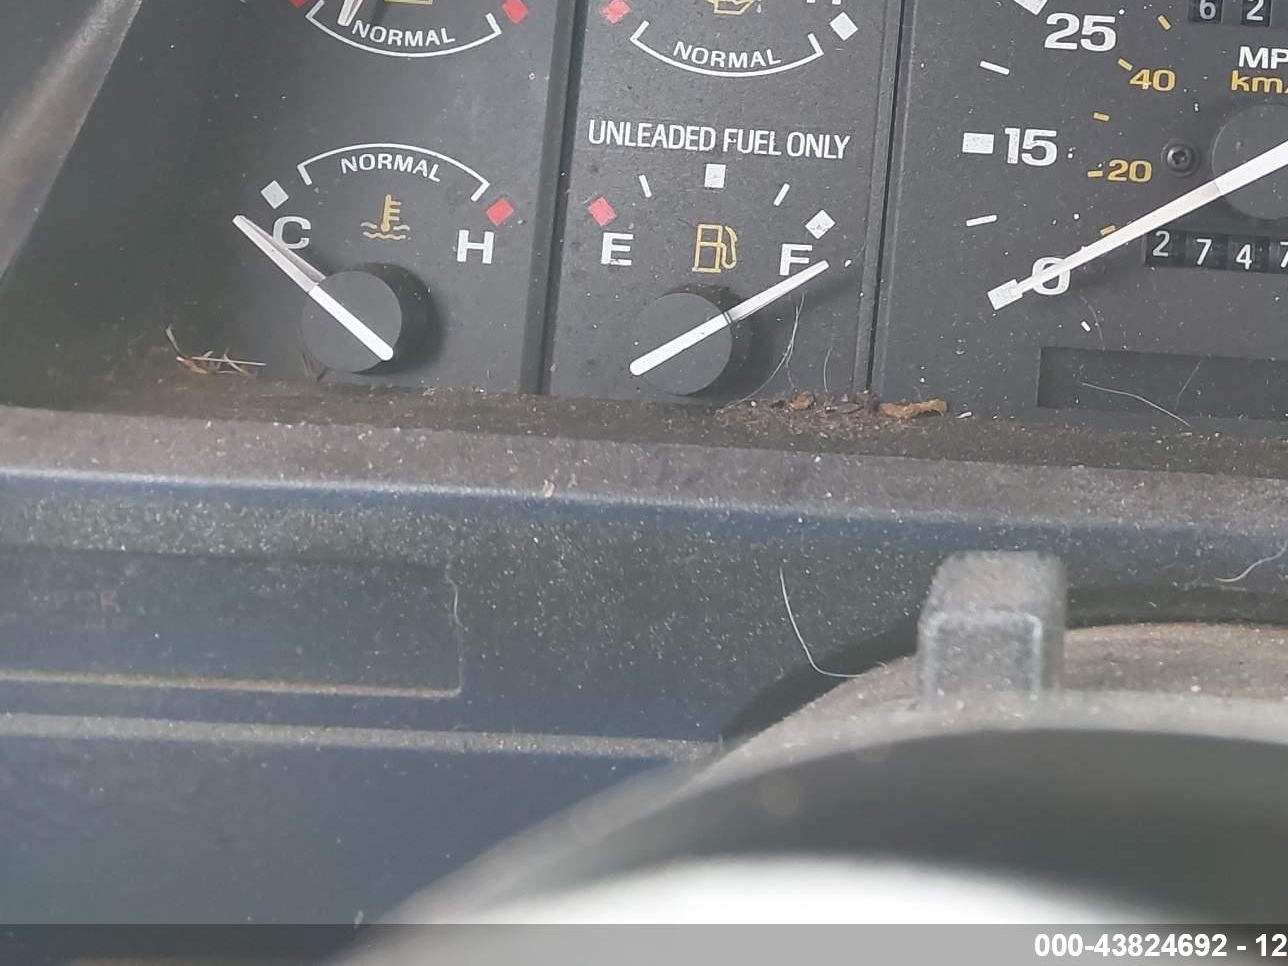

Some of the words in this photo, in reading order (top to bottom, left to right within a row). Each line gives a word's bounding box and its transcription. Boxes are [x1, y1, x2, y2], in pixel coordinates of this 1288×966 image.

[352, 19, 455, 48] NORMAL
[1045, 13, 1116, 51] 25
[673, 40, 782, 69] NORMAL
[1130, 70, 1175, 90] 40
[589, 120, 716, 151] UNLEADED
[723, 129, 781, 155] FUEL
[787, 132, 850, 158] ONLY
[1005, 128, 1057, 166] 15
[340, 153, 441, 183] NORMAL
[1108, 160, 1151, 182] 20
[273, 216, 311, 250] C
[457, 230, 494, 264] H
[601, 233, 633, 265] E
[779, 244, 813, 275] F
[1032, 257, 1071, 295] 0
